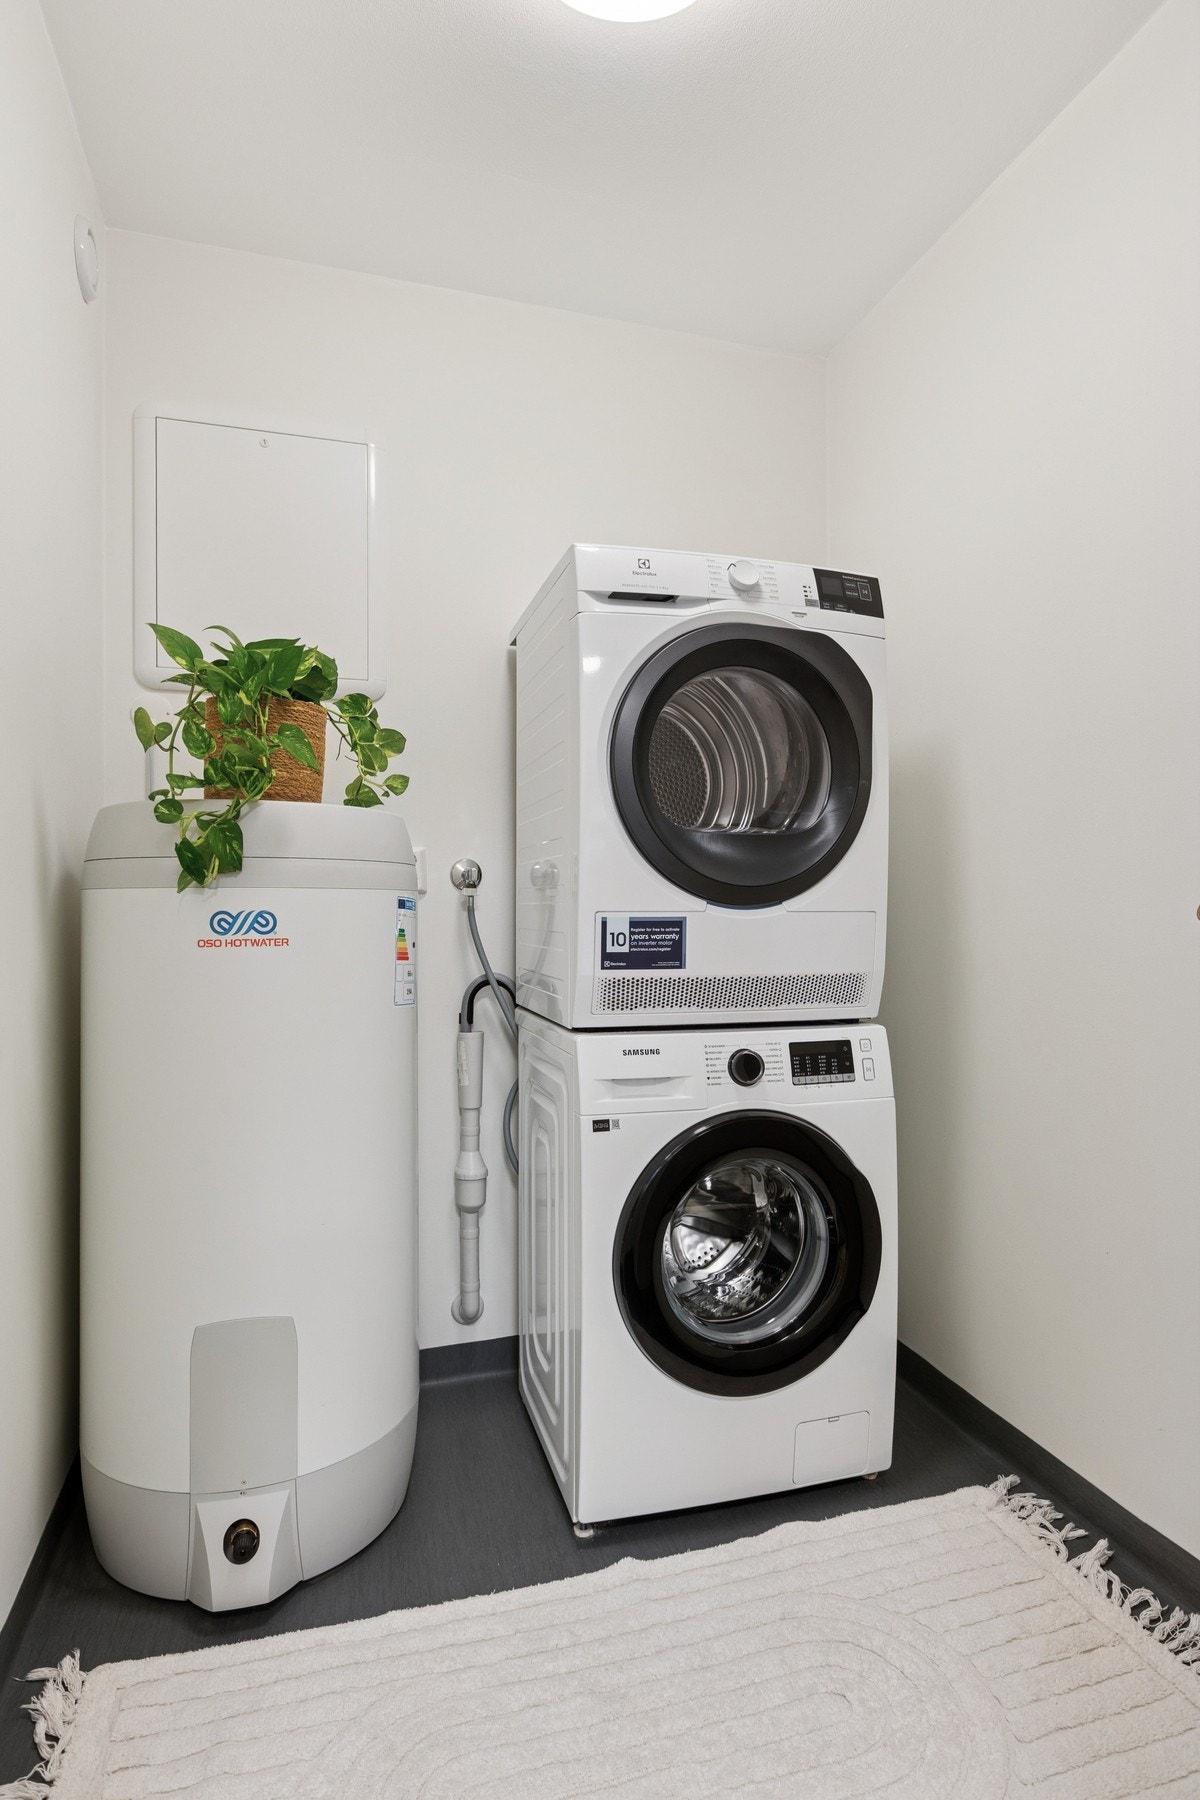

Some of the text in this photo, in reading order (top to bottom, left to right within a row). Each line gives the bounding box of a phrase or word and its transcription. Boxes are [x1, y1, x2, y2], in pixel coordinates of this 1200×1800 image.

[609, 932, 626, 947] 10
[650, 933, 680, 941] warranty
[197, 938, 289, 948] OSO HOTWATER
[622, 1048, 661, 1056] SAMSUNG
